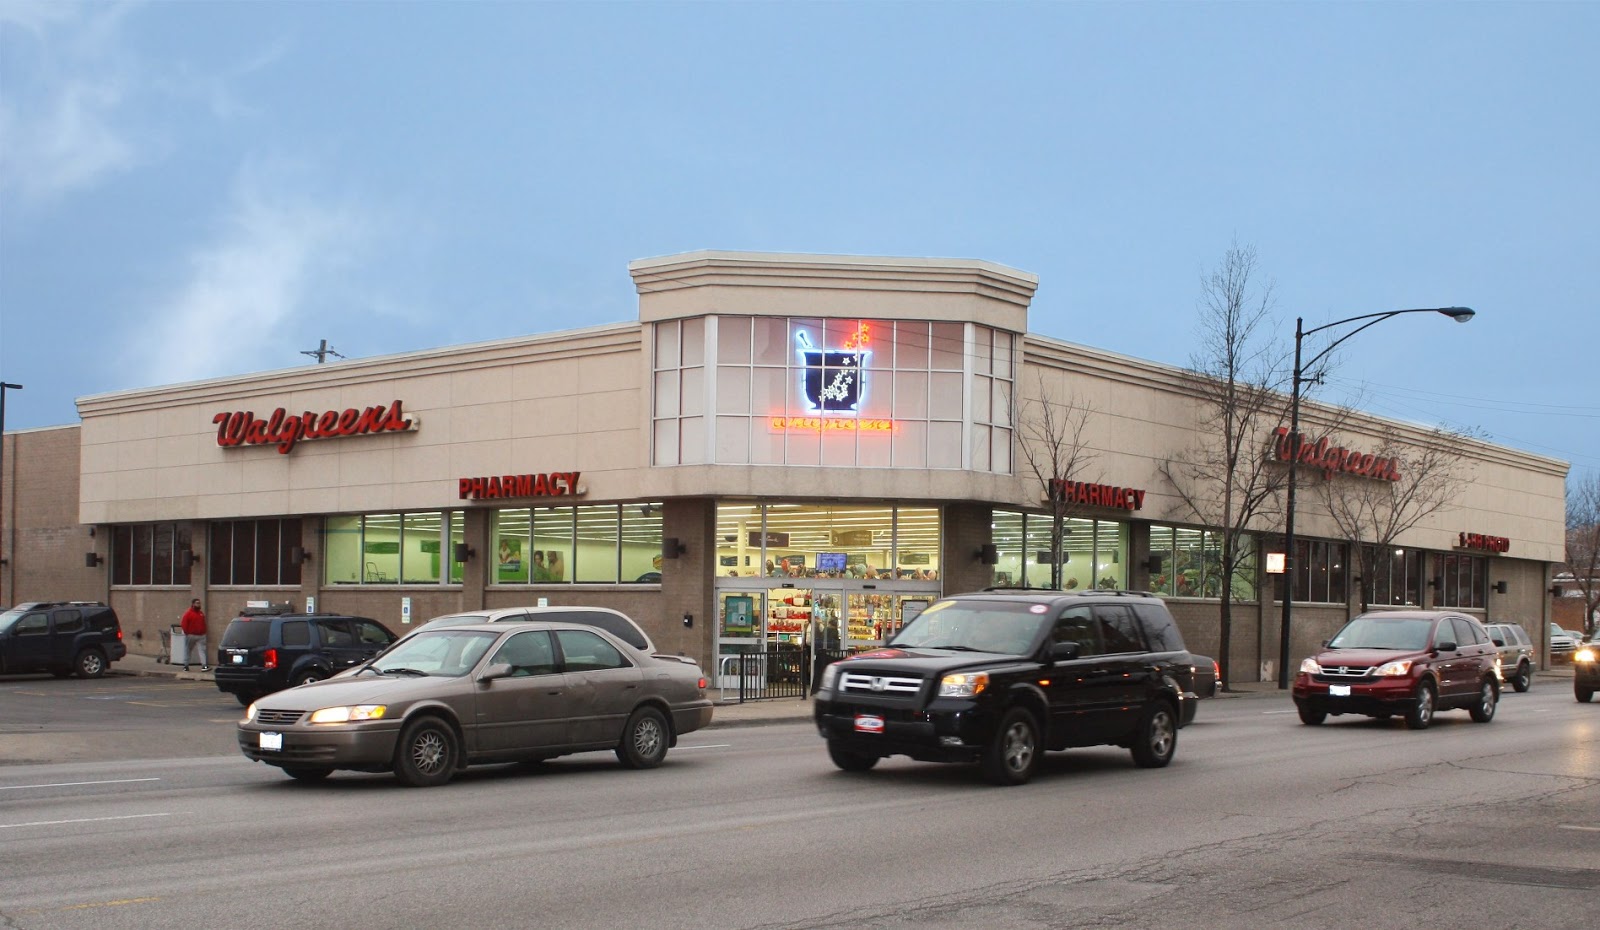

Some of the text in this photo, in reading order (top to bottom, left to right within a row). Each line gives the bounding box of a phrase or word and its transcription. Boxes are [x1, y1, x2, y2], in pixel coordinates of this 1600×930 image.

[213, 400, 411, 454] Walgreens
[1272, 427, 1401, 480] Walgreens
[459, 471, 580, 499] PHARMACY
